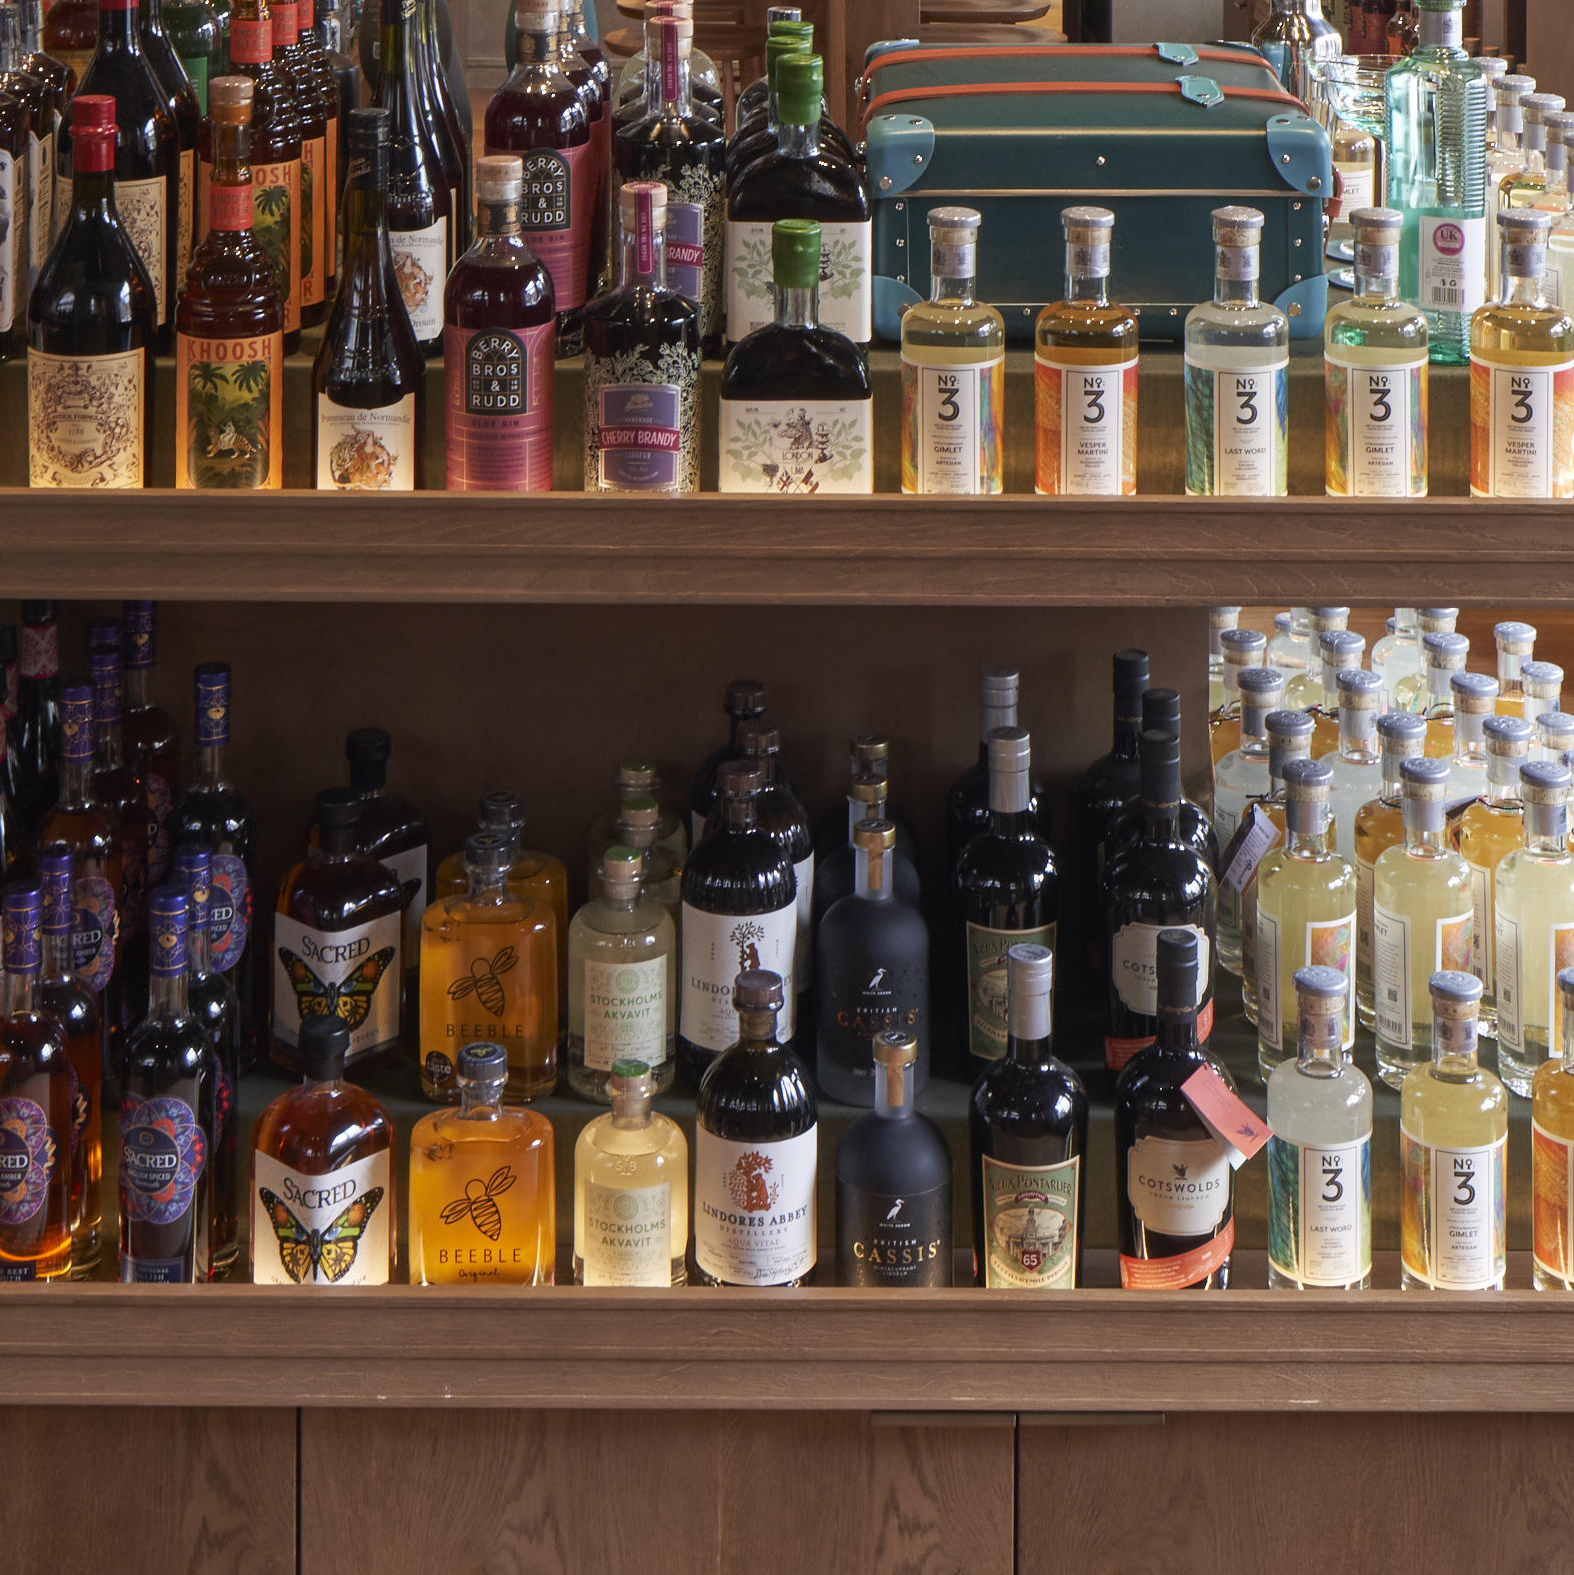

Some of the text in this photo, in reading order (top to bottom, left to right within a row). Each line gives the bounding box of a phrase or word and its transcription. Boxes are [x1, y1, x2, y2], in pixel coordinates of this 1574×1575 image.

[523, 155, 565, 180] BERRY
[522, 181, 563, 194] BROS
[538, 197, 547, 208] &
[520, 210, 565, 224] RUDD
[1440, 230, 1457, 240] UK
[186, 338, 272, 361] KHOOSH
[472, 335, 519, 360] BERRY
[472, 364, 518, 377] BROS
[490, 380, 501, 392] &
[472, 394, 520, 407] RUDD
[938, 388, 960, 421] 3
[1083, 390, 1105, 423] 3
[1236, 391, 1258, 424] 3
[1369, 389, 1391, 422] 3
[1511, 389, 1532, 423] 3
[320, 413, 412, 424] Pommeau de Normandie
[601, 430, 678, 446] CHERRY BRANDY
[1507, 441, 1535, 449] VESPER
[782, 450, 814, 462] LONDON
[934, 446, 963, 454] GIMLET
[1077, 448, 1109, 456] MARTINI
[1244, 447, 1267, 455] WORD
[1365, 446, 1394, 454] GIMLET
[1505, 448, 1537, 456] MARTINI
[302, 935, 371, 965] SACRED
[590, 992, 664, 1007] STOCKHOLMS
[603, 1006, 651, 1020] AKVAVIT
[857, 1006, 898, 1014] BRITISH
[836, 1009, 917, 1029] CASSIS
[446, 1022, 524, 1040] BEEBLE
[426, 1062, 451, 1075] taste
[123, 1145, 178, 1169] SACRED
[1, 1171, 22, 1180] AMBER
[148, 1172, 171, 1181] SPICED
[989, 1175, 1073, 1196] VIEUX PONTARLIER
[1138, 1175, 1221, 1194] COTSWOLDS
[1322, 1168, 1344, 1202] 3
[1454, 1171, 1475, 1205] 3
[283, 1177, 356, 1207] SACRED
[702, 1204, 808, 1226] LINDORES ABBEY
[589, 1218, 666, 1232] STOCKHOLMS
[719, 1225, 789, 1236] DISTILLERY
[1310, 1224, 1352, 1233] LAST WORD
[1449, 1230, 1478, 1238] GIMLET
[601, 1235, 652, 1249] AKVAVIT
[728, 1237, 780, 1247] AQUA VITAE
[873, 1238, 917, 1246] BRITISH
[439, 1248, 521, 1263] BEEBLE
[853, 1241, 938, 1264] CASSIS
[1022, 1253, 1038, 1267] 65
[459, 1267, 499, 1279] Original
